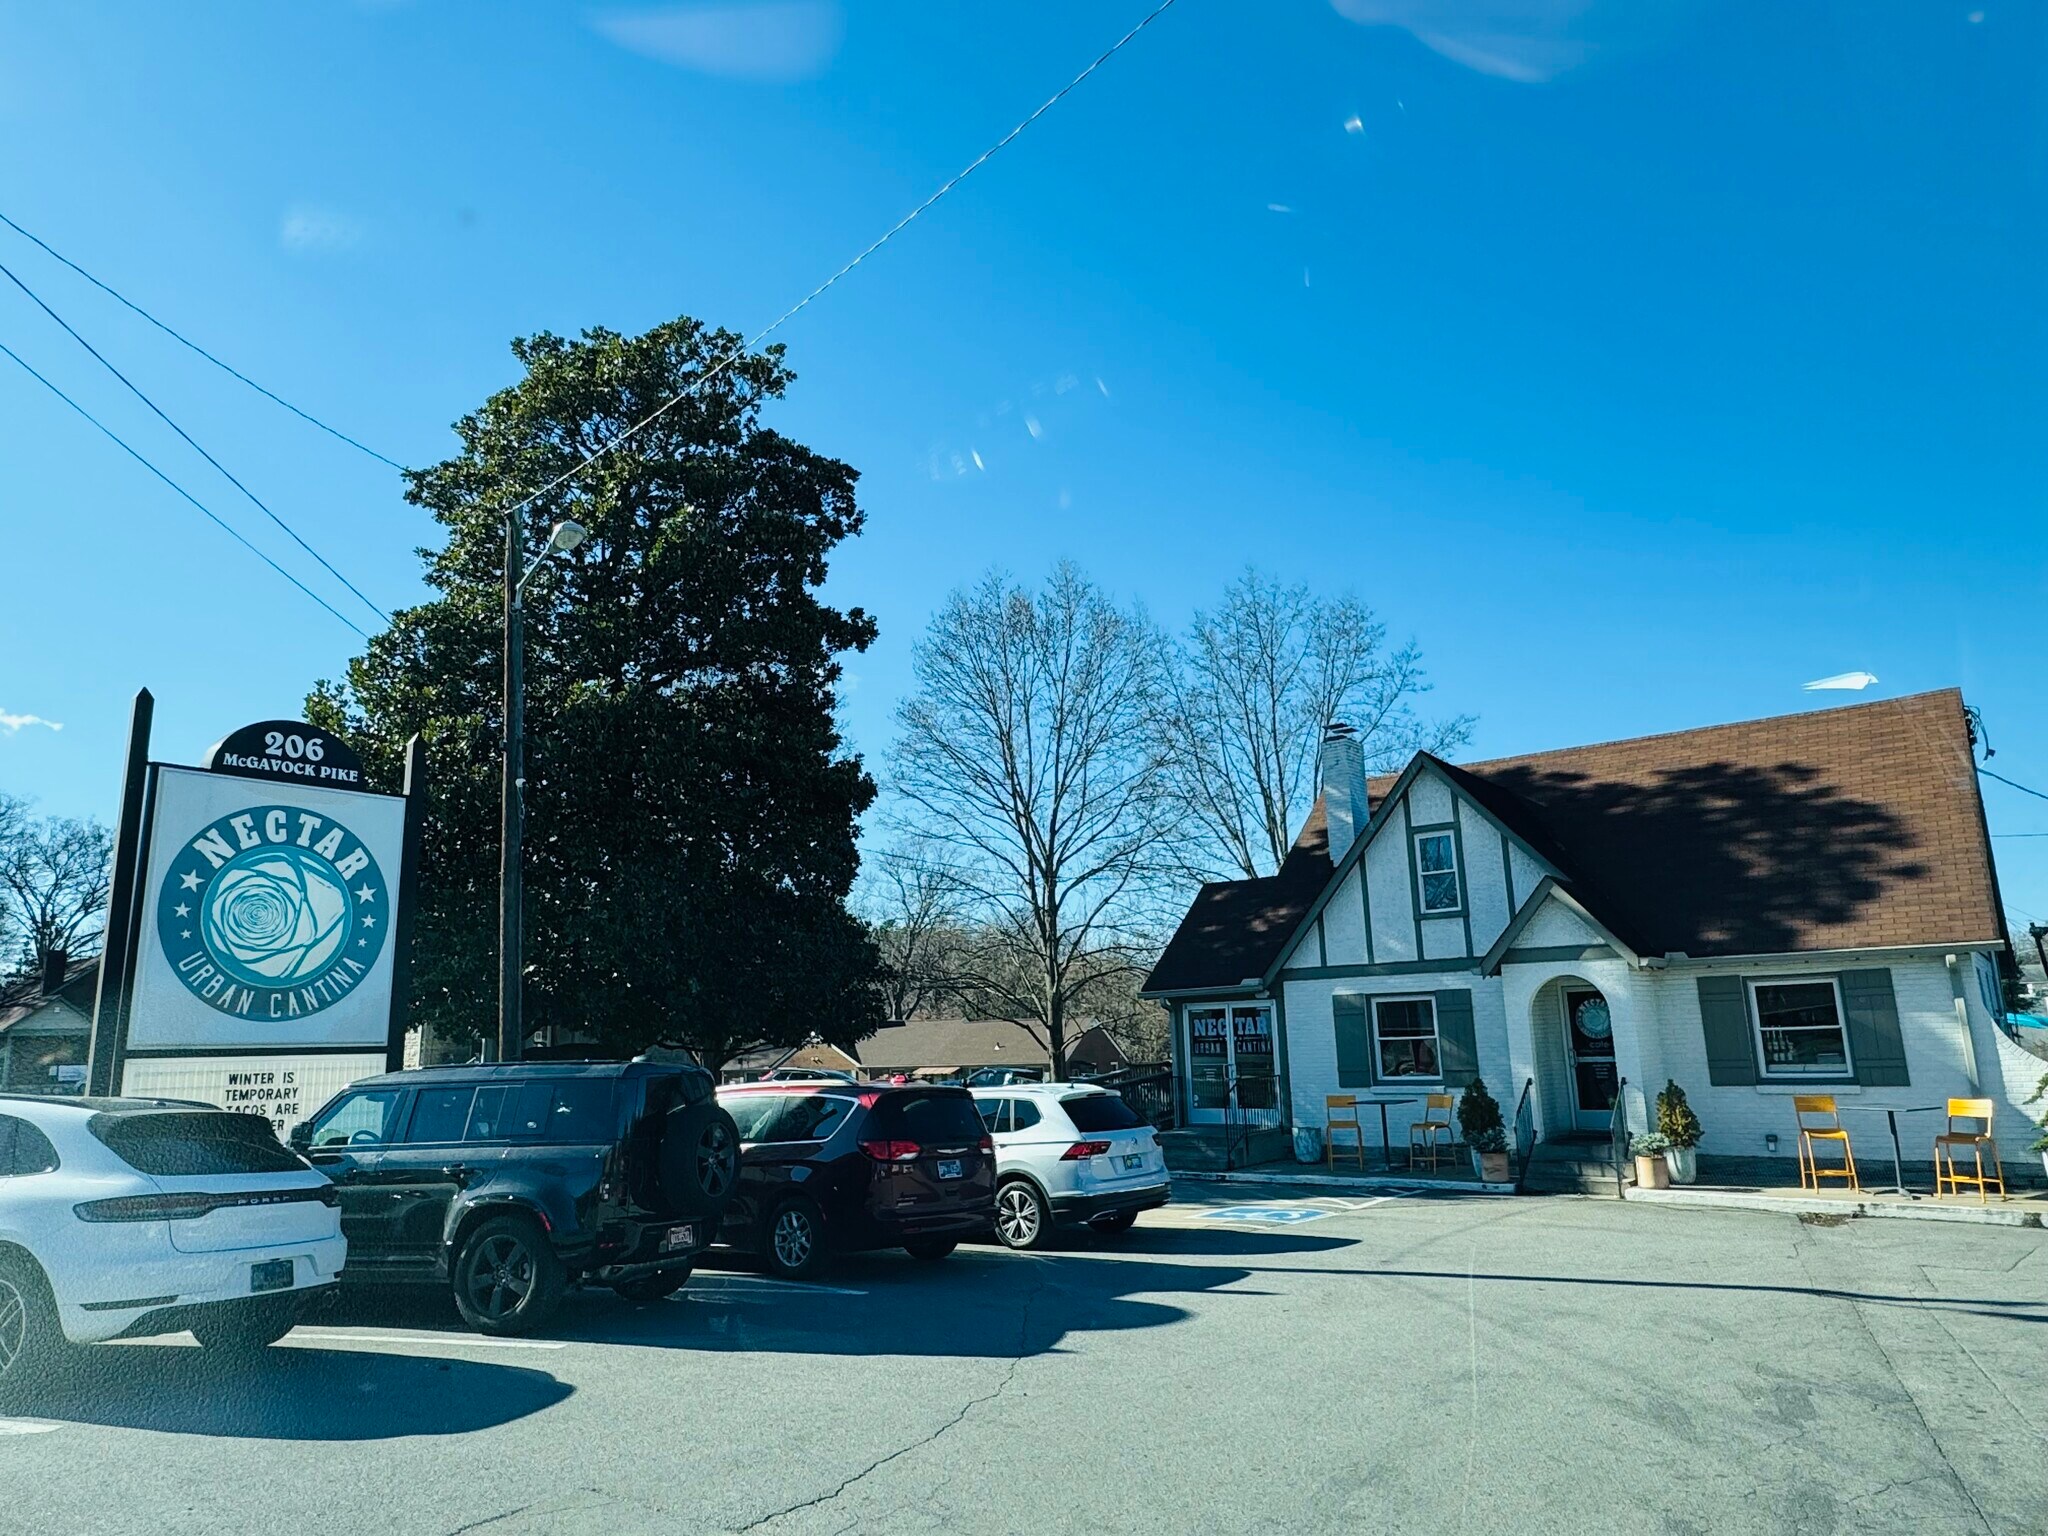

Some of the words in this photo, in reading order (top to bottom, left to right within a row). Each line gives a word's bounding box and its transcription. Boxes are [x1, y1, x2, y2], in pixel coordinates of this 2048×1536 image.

[264, 731, 324, 762] 206
[222, 752, 316, 777] McGAVOCK
[319, 766, 359, 783] PIKE
[192, 809, 370, 881] NECTAR
[178, 951, 255, 1015] URBAN
[269, 956, 366, 1018] CANTINA
[1237, 1040, 1272, 1053] CANTINA
[228, 1072, 275, 1086] WINTER
[282, 1071, 295, 1084] IS
[225, 1087, 299, 1102] TEMPORARY
[275, 1103, 300, 1116] ARE
